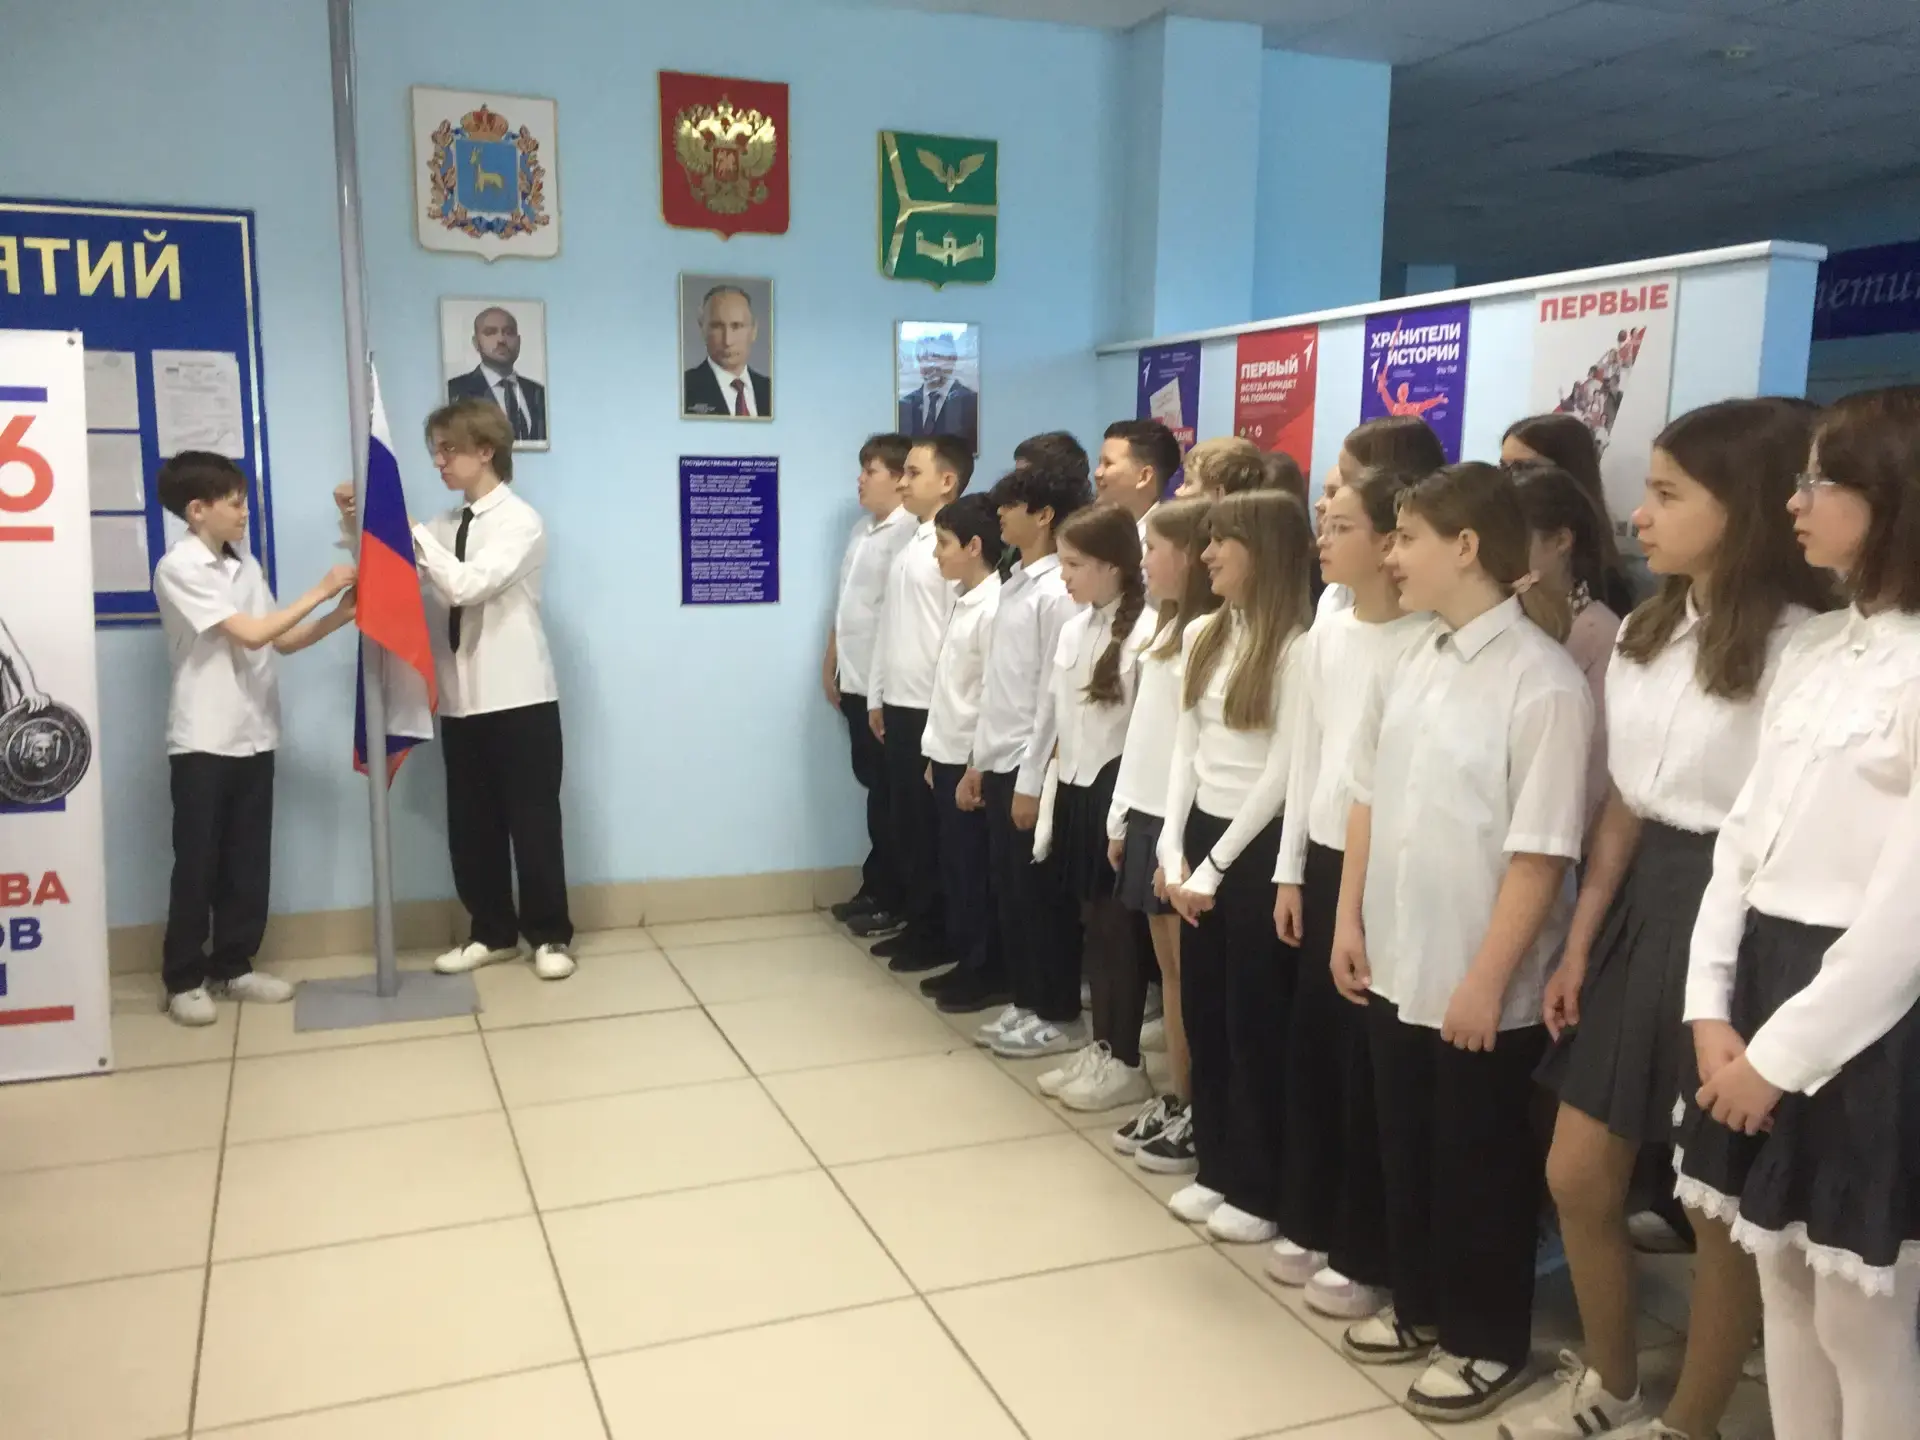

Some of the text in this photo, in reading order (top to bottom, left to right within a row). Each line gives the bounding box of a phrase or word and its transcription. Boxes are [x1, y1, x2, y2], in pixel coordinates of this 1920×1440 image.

[1540, 283, 1669, 323] ПЕРВЫЕ
[1370, 322, 1461, 349] ХРАНИТЕЛИ
[1241, 353, 1299, 379] ПЕРВЫЙ
[1386, 342, 1460, 367] ИСТОРИИ
[0, 415, 54, 513] 6
[0, 917, 43, 952] В
